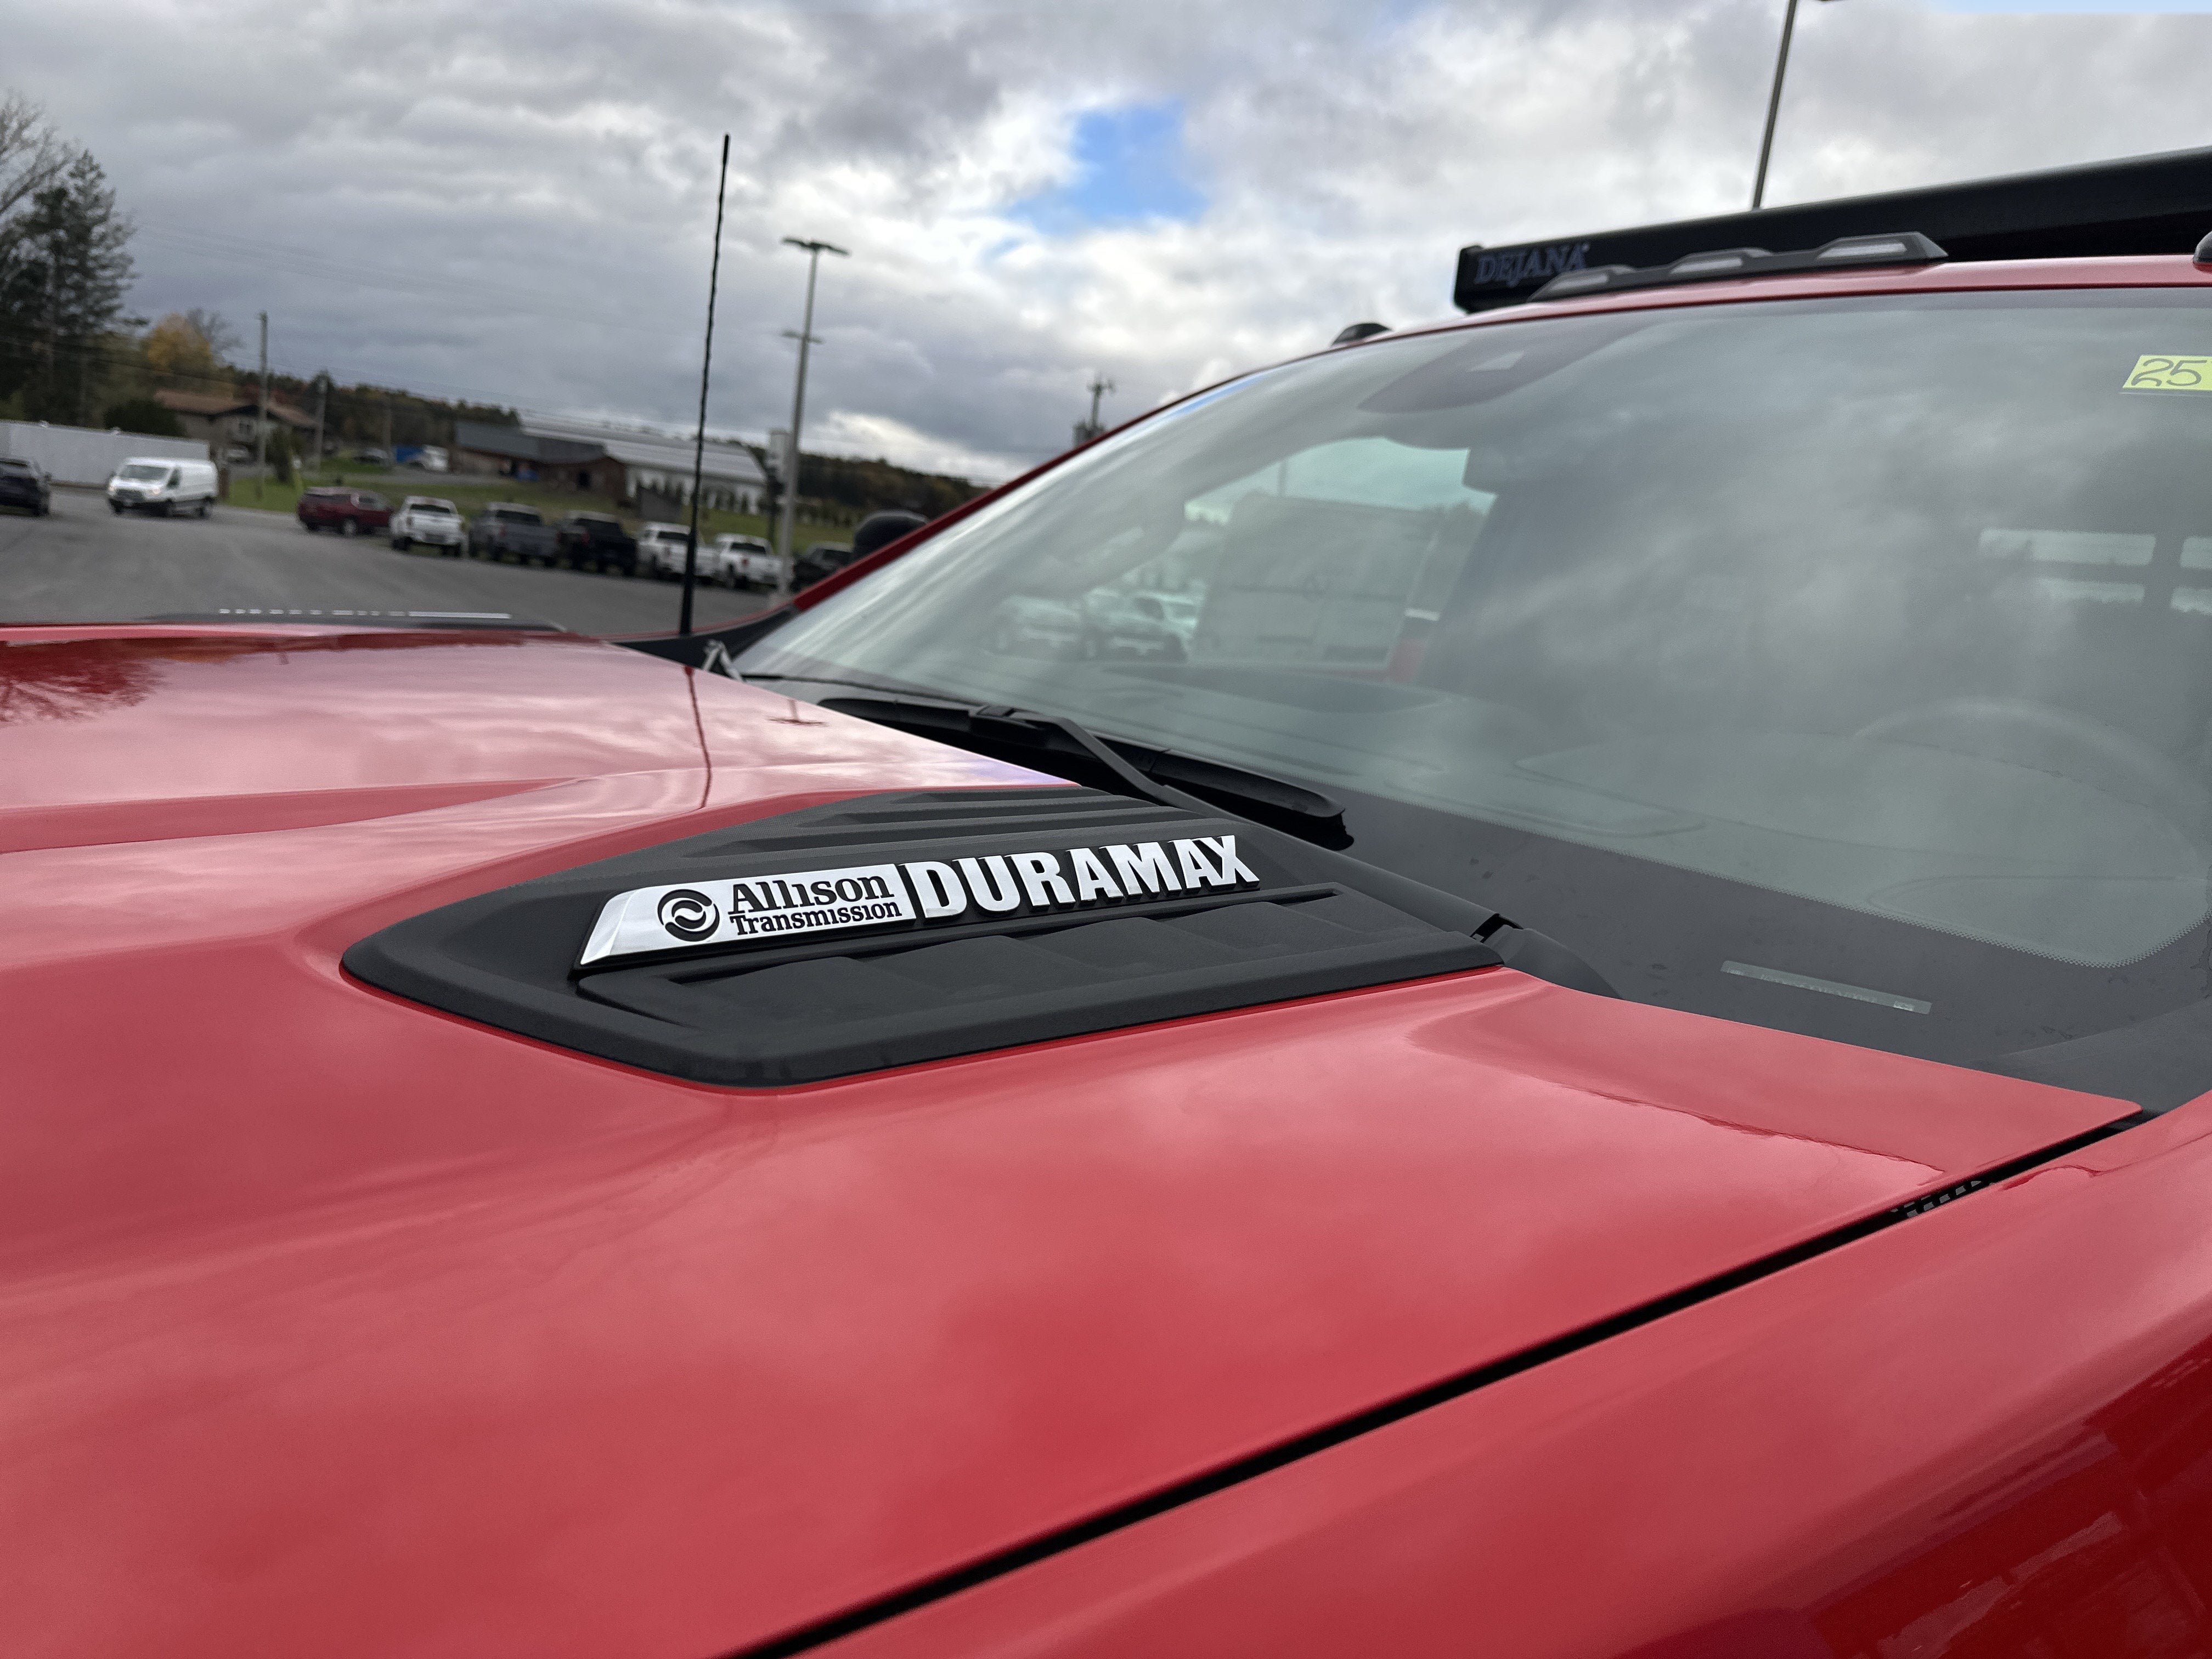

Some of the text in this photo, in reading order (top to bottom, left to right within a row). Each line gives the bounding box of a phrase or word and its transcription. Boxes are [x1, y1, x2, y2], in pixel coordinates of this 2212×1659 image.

[2131, 358, 2208, 387] 25
[900, 834, 1260, 920] DURAMAX
[728, 876, 895, 915] Allison
[730, 901, 902, 935] Transmission
